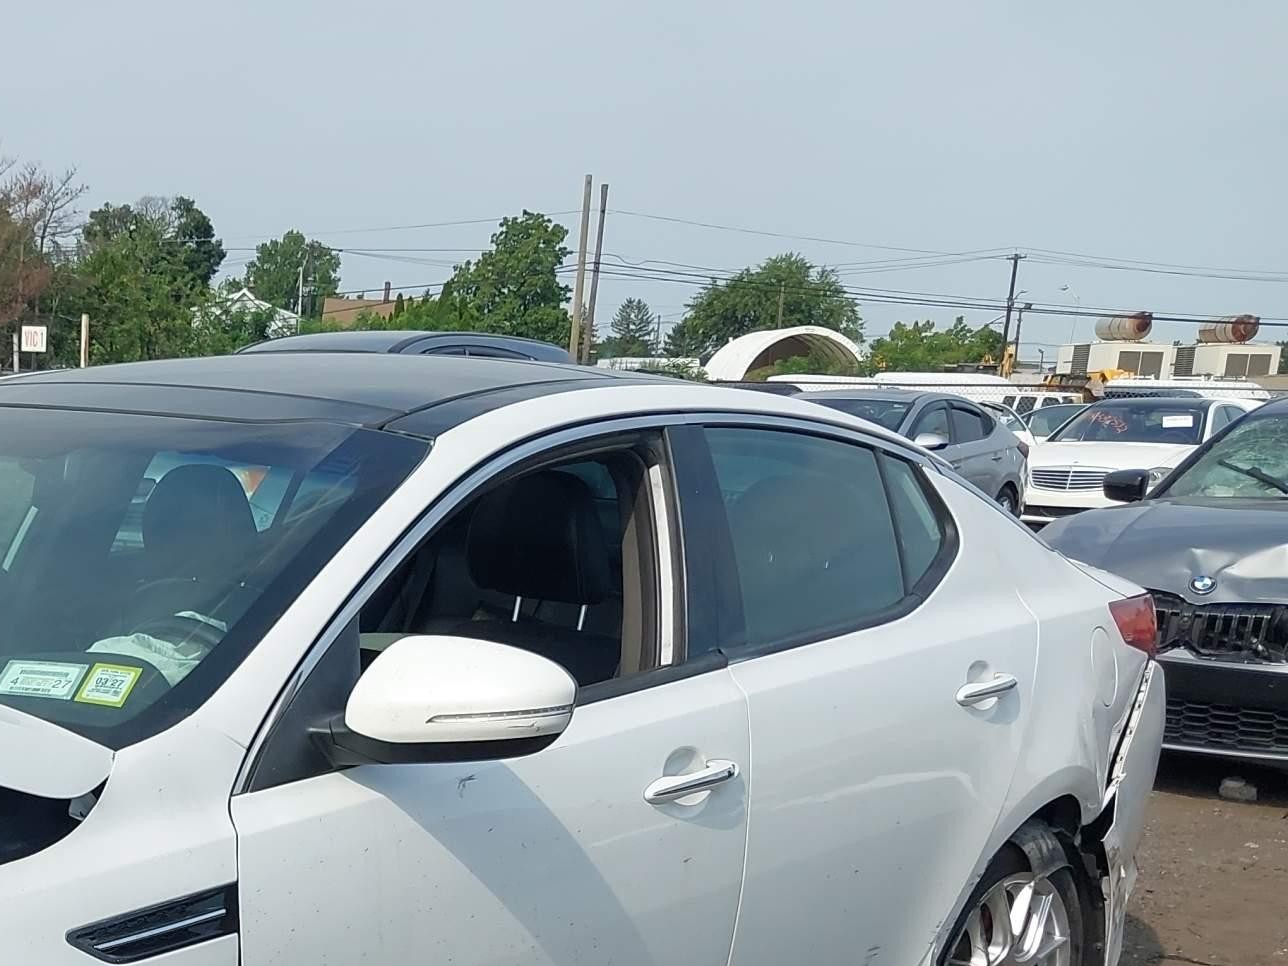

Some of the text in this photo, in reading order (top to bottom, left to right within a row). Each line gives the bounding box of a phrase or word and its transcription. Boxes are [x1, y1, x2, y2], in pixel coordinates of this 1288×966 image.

[10, 677, 73, 689] 4 27
[95, 677, 125, 688] 03 27
